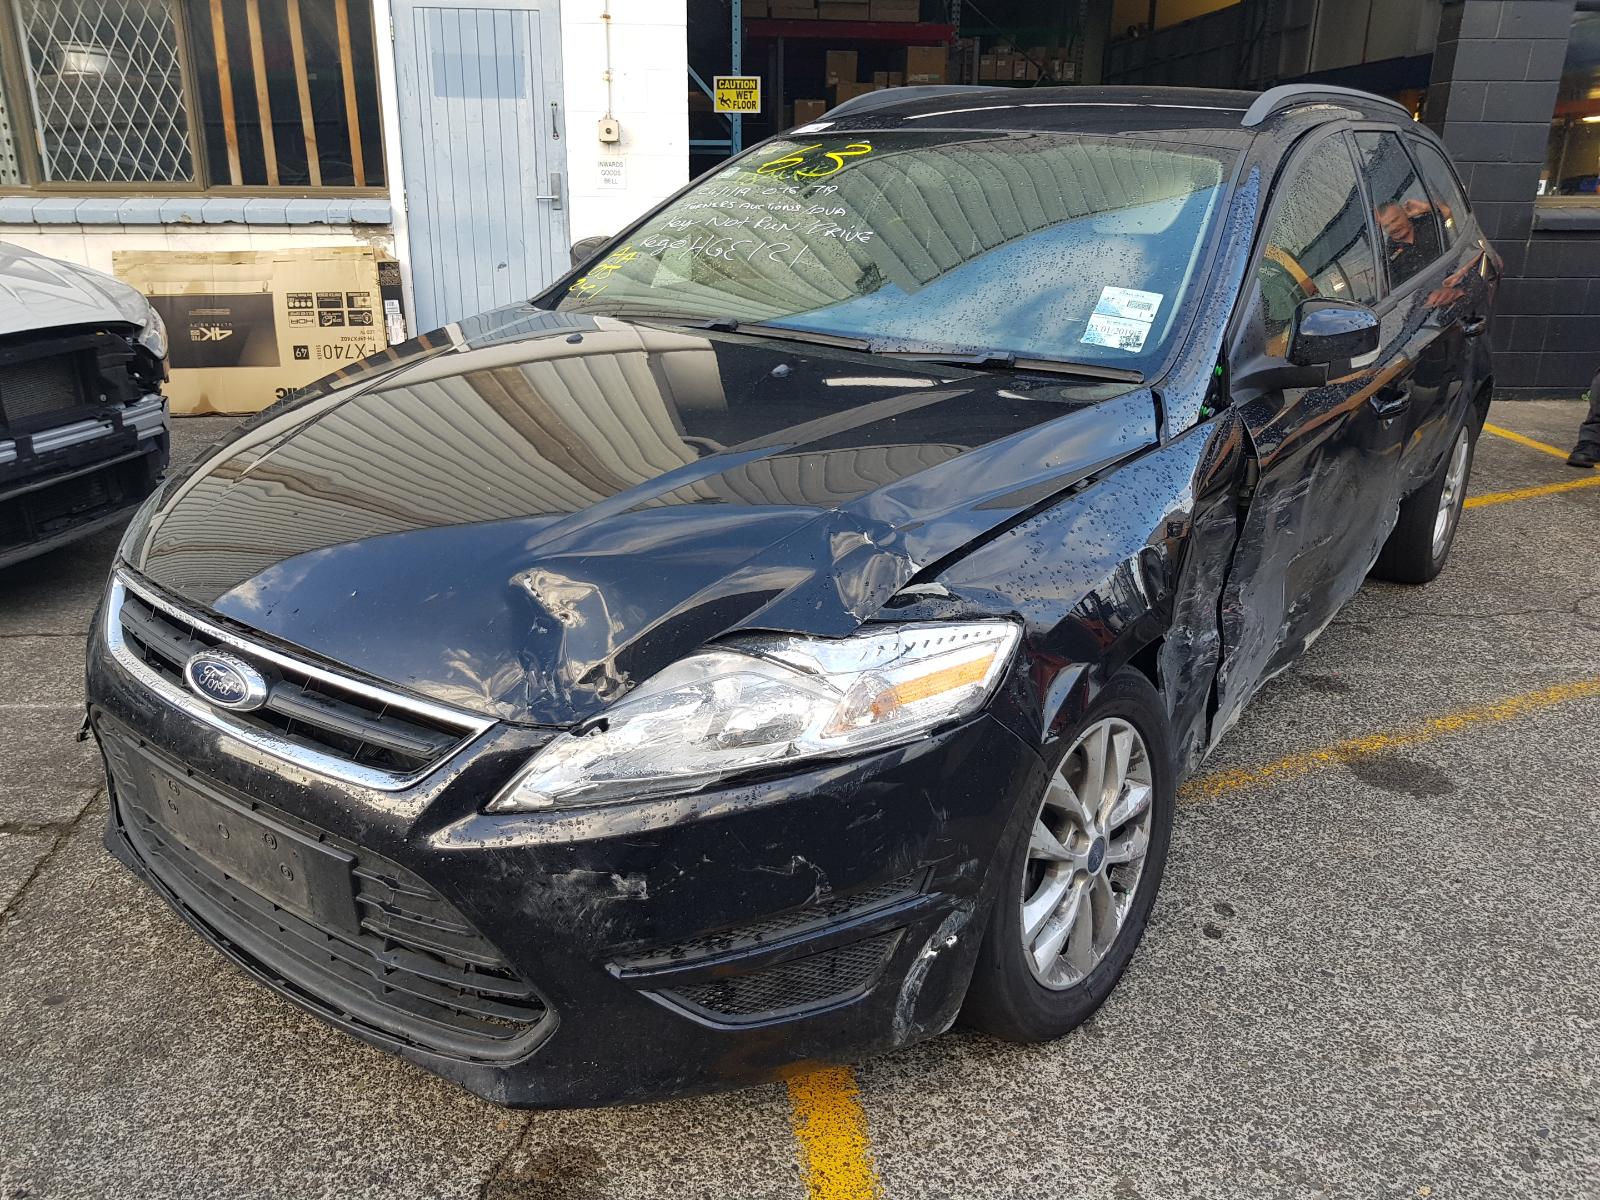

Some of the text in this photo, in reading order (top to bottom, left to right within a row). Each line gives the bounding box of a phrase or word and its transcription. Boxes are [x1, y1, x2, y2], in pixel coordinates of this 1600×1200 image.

[718, 80, 756, 89] CAUTION
[736, 91, 754, 100] WET
[733, 100, 757, 110] FLOOR
[199, 327, 233, 341] 4K
[295, 347, 308, 357] 49
[323, 343, 377, 360] FX740
[199, 665, 235, 696] Ford
